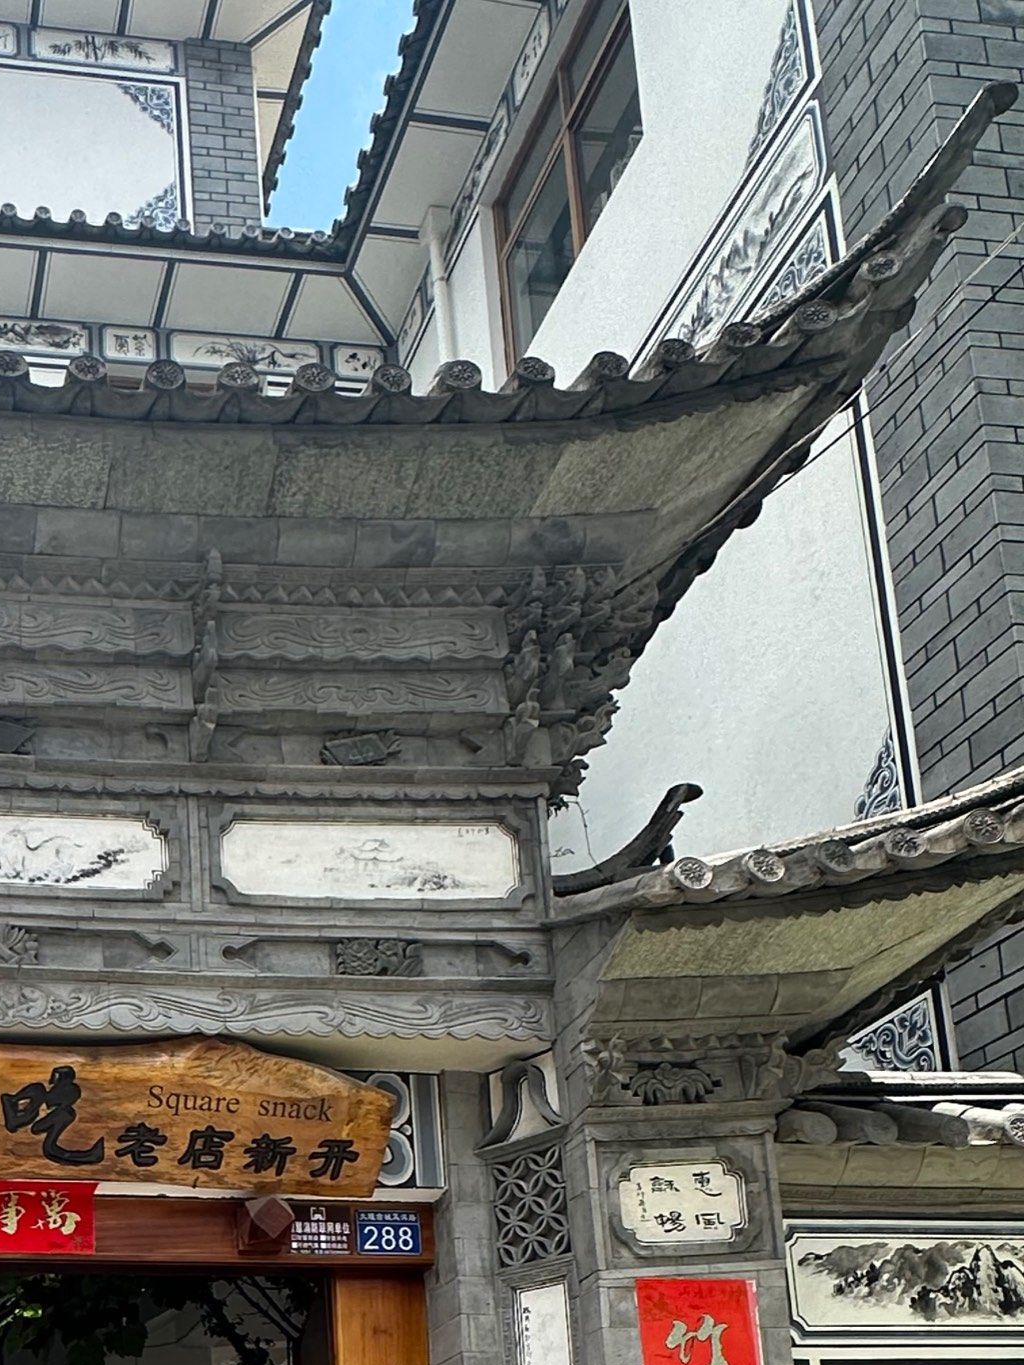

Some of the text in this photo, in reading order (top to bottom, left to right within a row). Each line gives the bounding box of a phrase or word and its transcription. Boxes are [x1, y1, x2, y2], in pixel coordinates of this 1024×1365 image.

[147, 1084, 333, 1122] Square snack
[115, 1122, 360, 1181] 老店新开
[363, 1226, 414, 1251] 288
